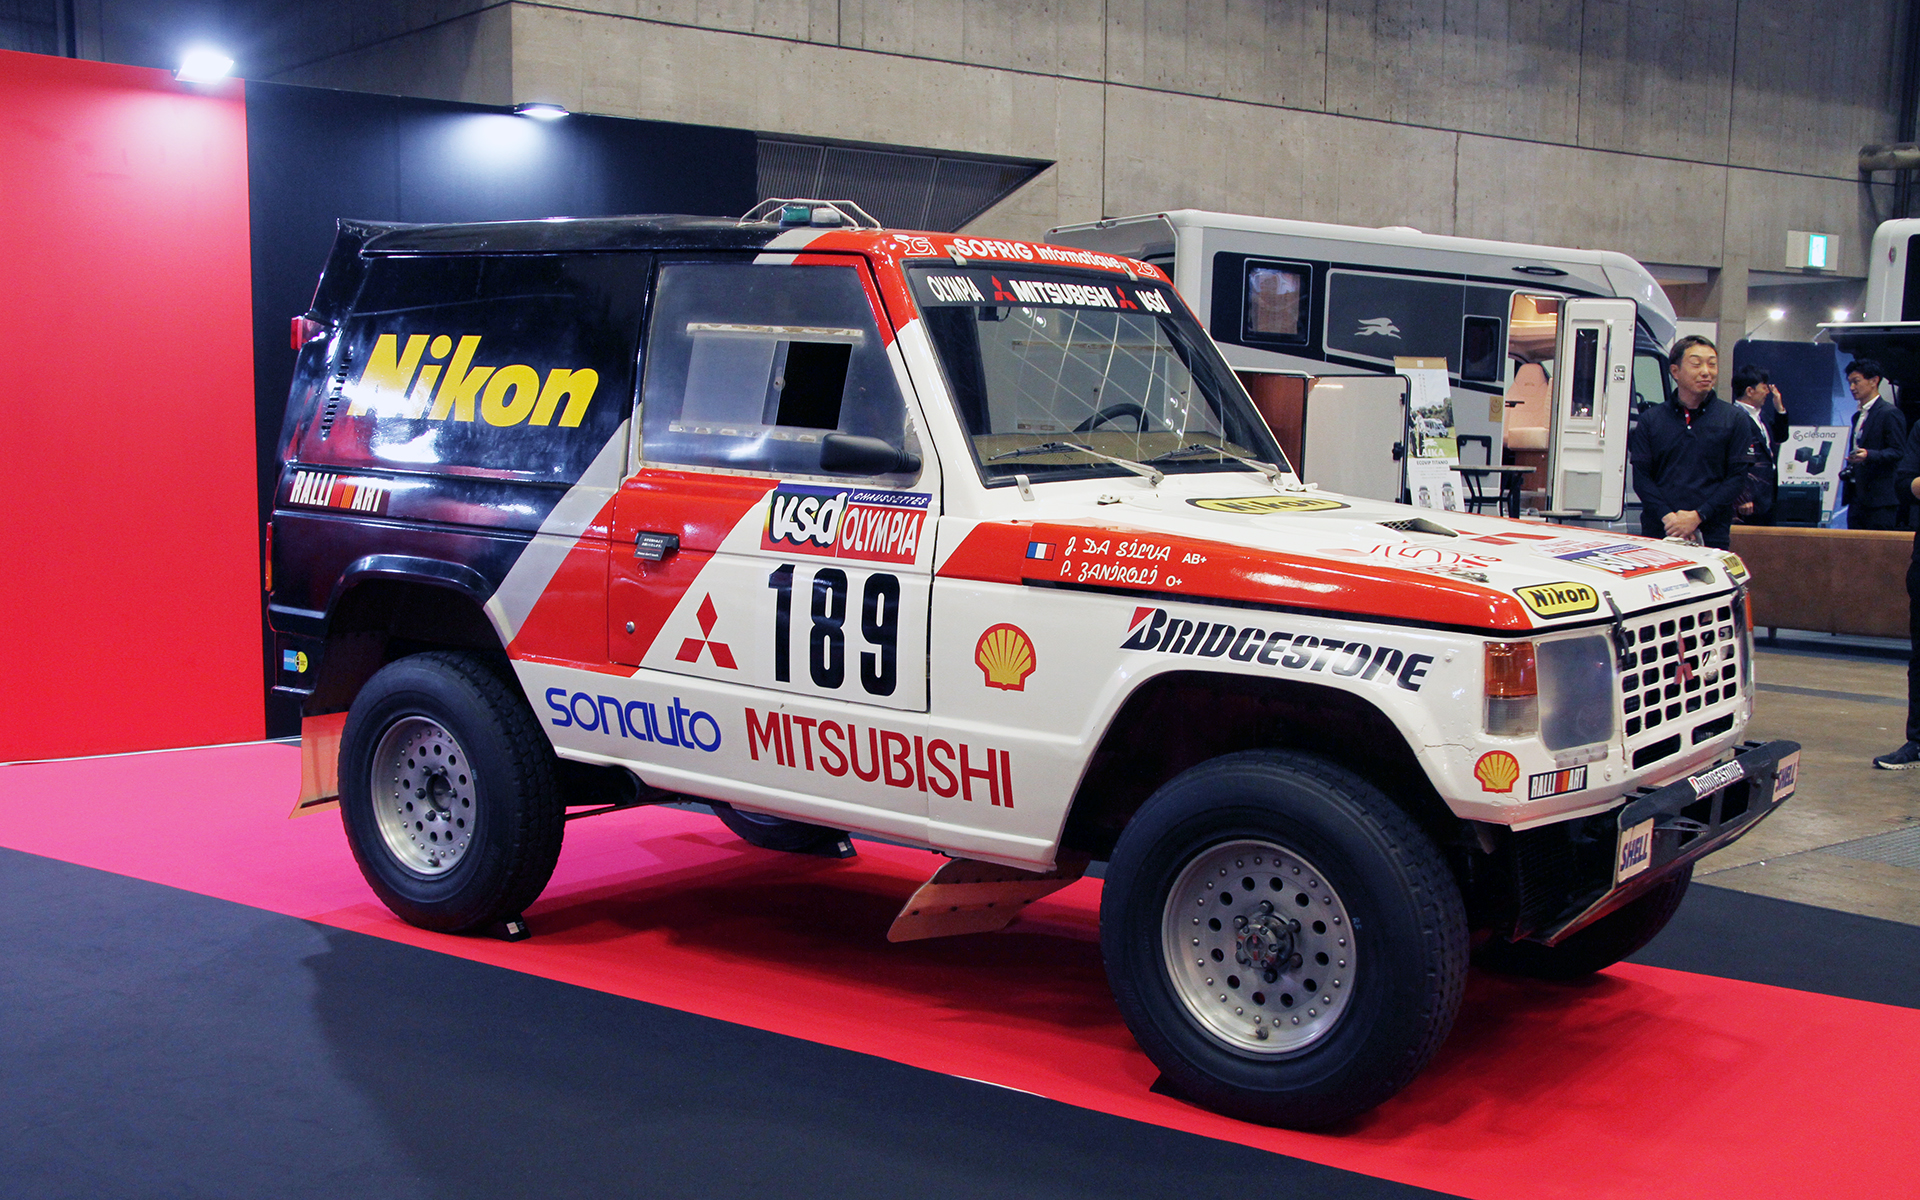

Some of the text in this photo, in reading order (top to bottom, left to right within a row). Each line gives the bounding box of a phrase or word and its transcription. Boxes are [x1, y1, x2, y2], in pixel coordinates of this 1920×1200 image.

[953, 238, 1121, 269] SOFRIG Informatique
[926, 275, 986, 302] OLYMPIA
[1008, 280, 1118, 308] MITSUBISHI
[346, 334, 599, 427] Nikon
[1416, 448, 1445, 458] LAIKA
[289, 471, 337, 507] RALLI
[853, 492, 929, 506] CHAUSSETTES
[1216, 500, 1326, 511] Nikon
[842, 507, 920, 556] OLYMPIA
[1083, 537, 1111, 555] DA
[1115, 539, 1171, 561] SILVA
[1181, 553, 1207, 565] AB+
[1533, 586, 1590, 609] Nikon
[768, 563, 900, 697] 189
[1119, 606, 1435, 693] BRIDGESTONE
[545, 687, 721, 753] sonauto
[745, 708, 1014, 809] MITSUBISHI
[1531, 767, 1586, 798] RALLI ART
[1774, 762, 1797, 793] SHELL
[1620, 833, 1648, 872] SHELL
